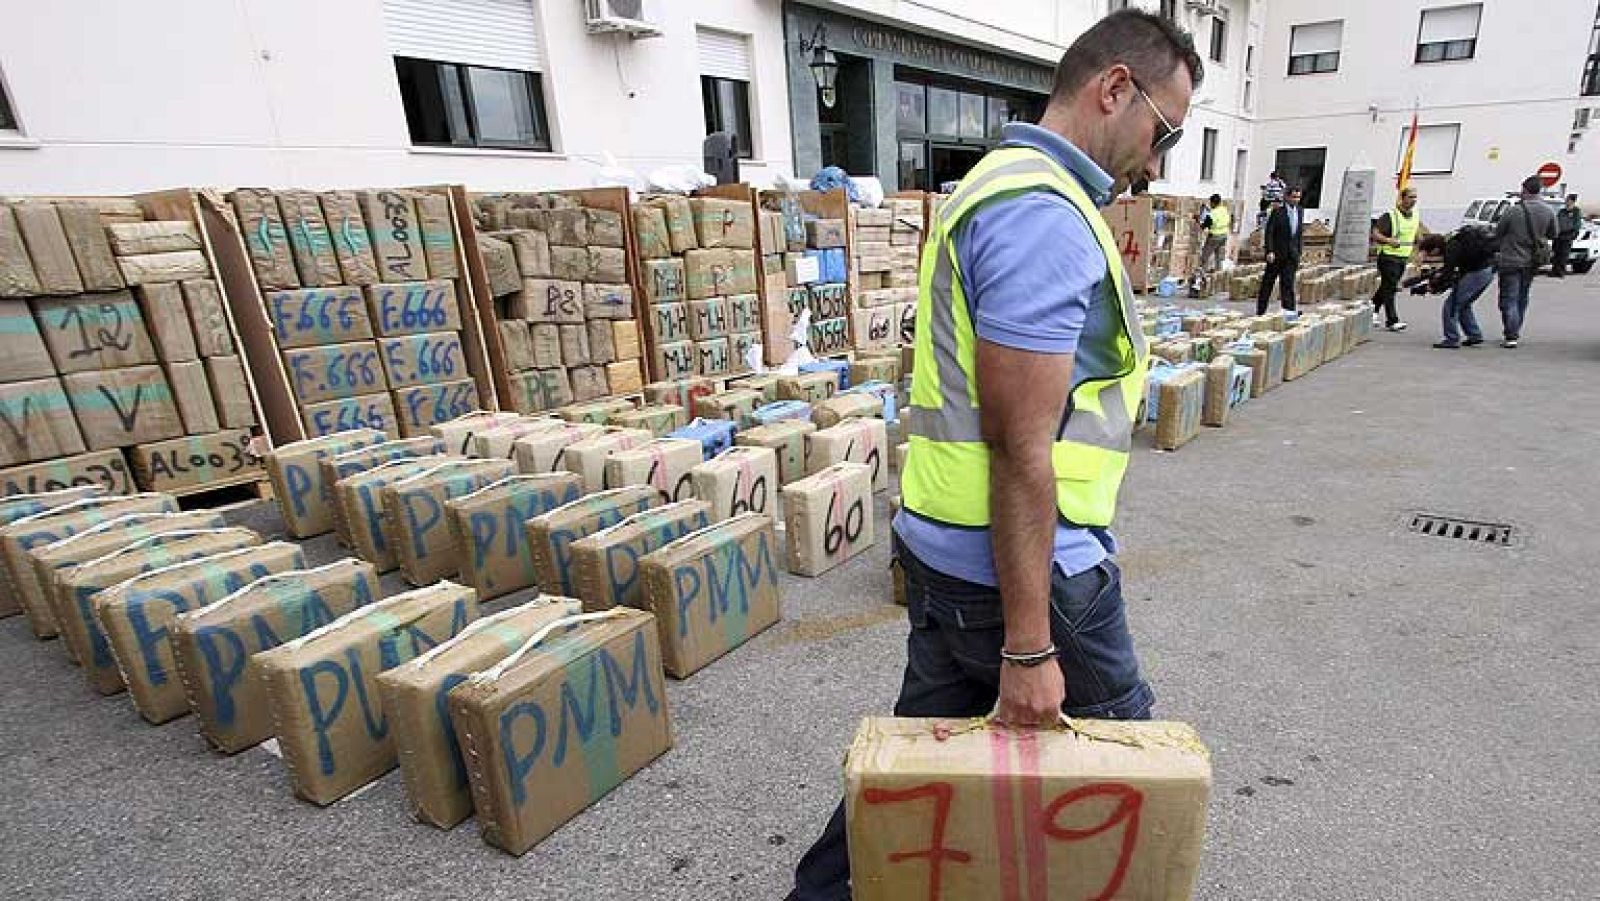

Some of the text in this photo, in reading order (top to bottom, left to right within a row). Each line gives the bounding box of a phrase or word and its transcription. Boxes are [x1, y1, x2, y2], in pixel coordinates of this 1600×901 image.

[59, 304, 133, 360] 12
[381, 291, 448, 332] F.666
[386, 341, 459, 382] F.666
[97, 383, 142, 432] V
[825, 491, 864, 557] 60
[674, 531, 778, 637] PNM
[499, 629, 660, 808] PNM
[862, 782, 1145, 901] 79
